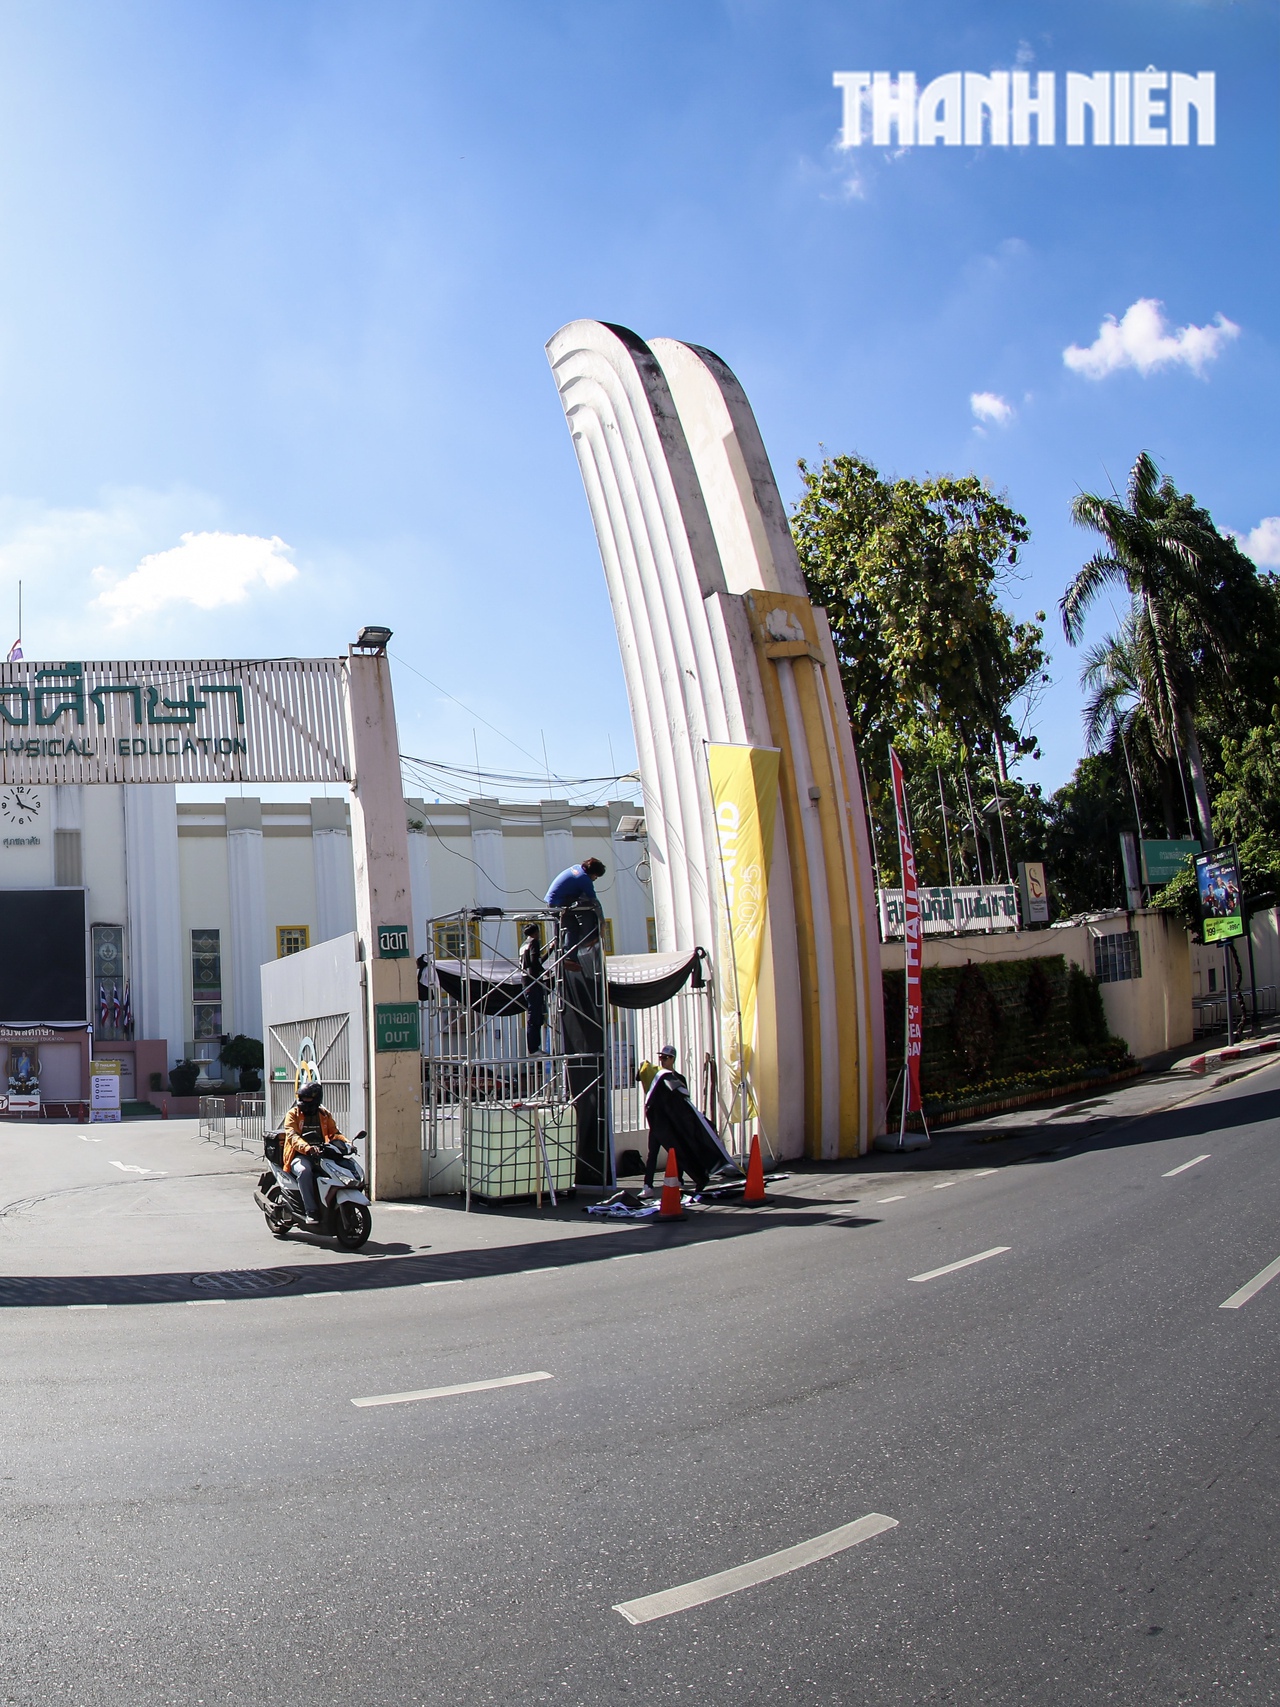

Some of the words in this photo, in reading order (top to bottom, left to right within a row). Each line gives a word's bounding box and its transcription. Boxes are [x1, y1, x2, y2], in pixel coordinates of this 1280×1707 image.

[118, 737, 248, 756] EDUCATION
[16, 786, 25, 794] 12
[18, 817, 24, 825] 6
[735, 864, 762, 939] 2025
[380, 932, 409, 950] ออก
[379, 1012, 416, 1025] ทางออก
[385, 1031, 410, 1043] OUT
[908, 1023, 921, 1038] EA
